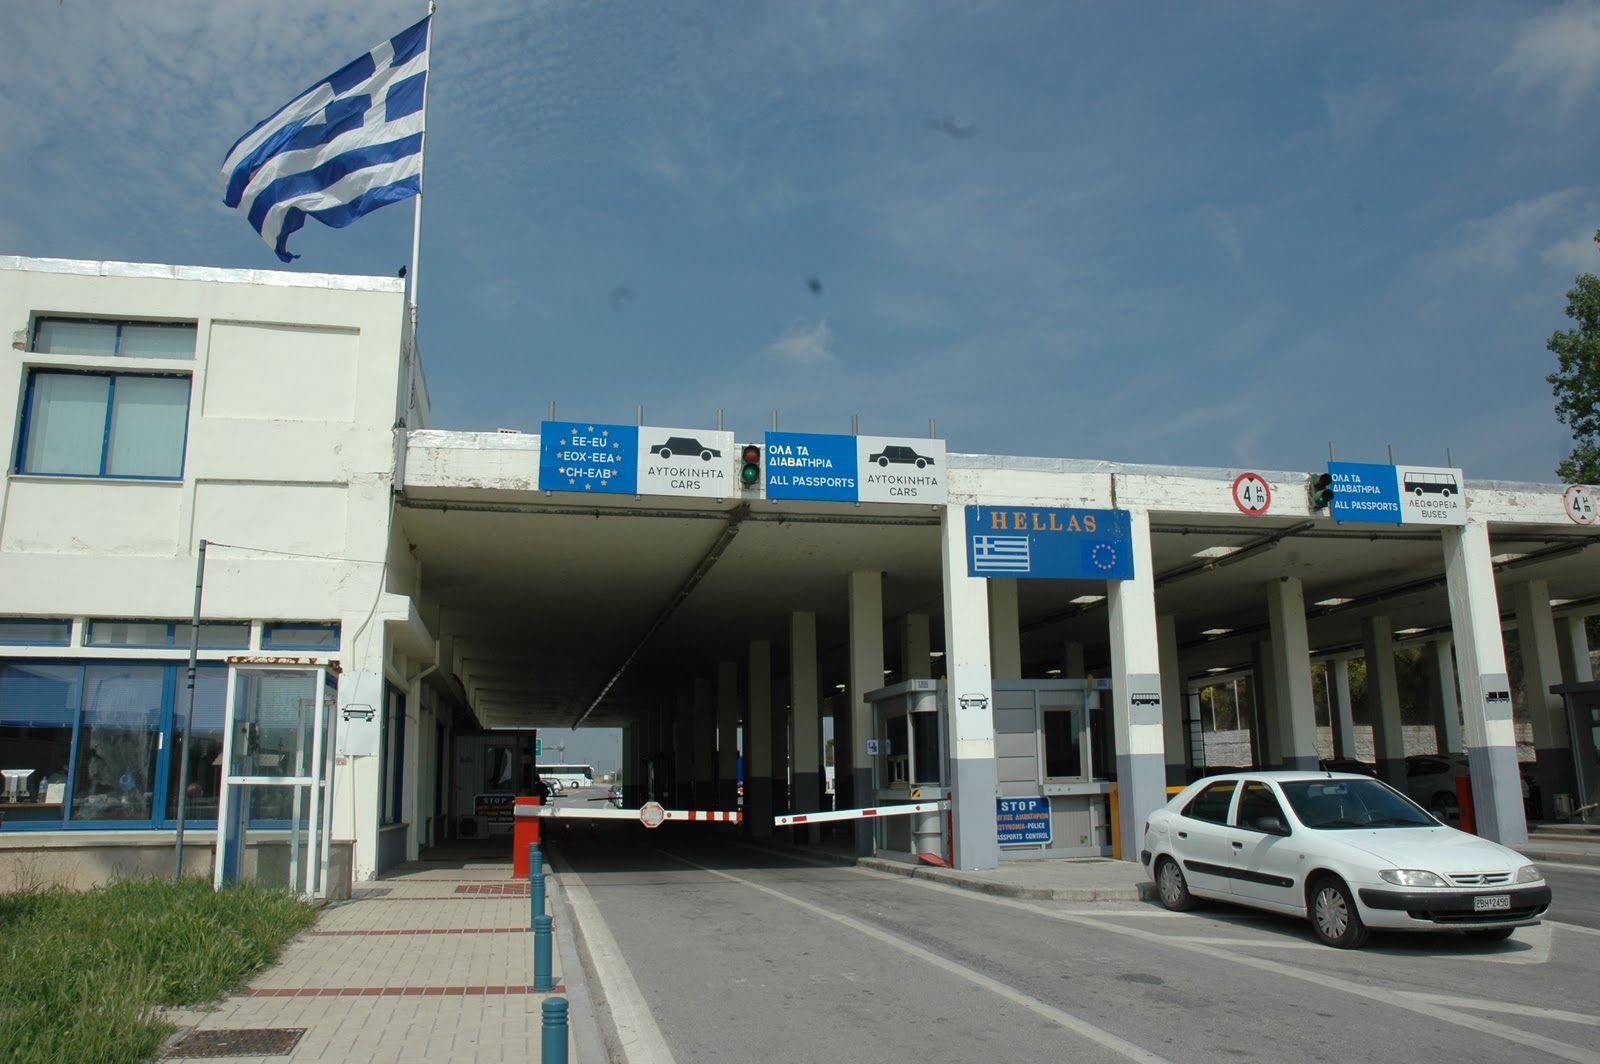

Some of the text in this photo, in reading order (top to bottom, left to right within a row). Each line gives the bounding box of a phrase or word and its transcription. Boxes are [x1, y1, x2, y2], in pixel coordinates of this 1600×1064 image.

[572, 436, 607, 447] ΕΕ-EU
[769, 445, 809, 456] ΟΛΑ ΤΑ
[769, 457, 833, 469] ΔΙΑΒΑΤΗΡΙΑ
[648, 466, 724, 479] ΑΥΤΟΚΙΝΗΤΑ
[1331, 473, 1361, 483] ΟΛΑ ΤΑ
[670, 480, 701, 490] CARS
[769, 475, 855, 488] ALL PASSPORTS
[867, 474, 938, 486] ΑΥΤΟΚΙΝΗΤΑ
[889, 487, 918, 497] CARS
[1243, 486, 1251, 502] 4
[1333, 484, 1381, 494] ΔΙΑΒΑΤΗΡΙΑ
[1334, 500, 1399, 511] ALL PASSPORTS
[1409, 499, 1458, 509] ΛΕΩΦΟΡΕΙΑ
[1573, 497, 1581, 512] 4
[1421, 510, 1448, 519] BUSES
[990, 511, 1097, 533] HELLAS
[1001, 801, 1037, 811] STOP
